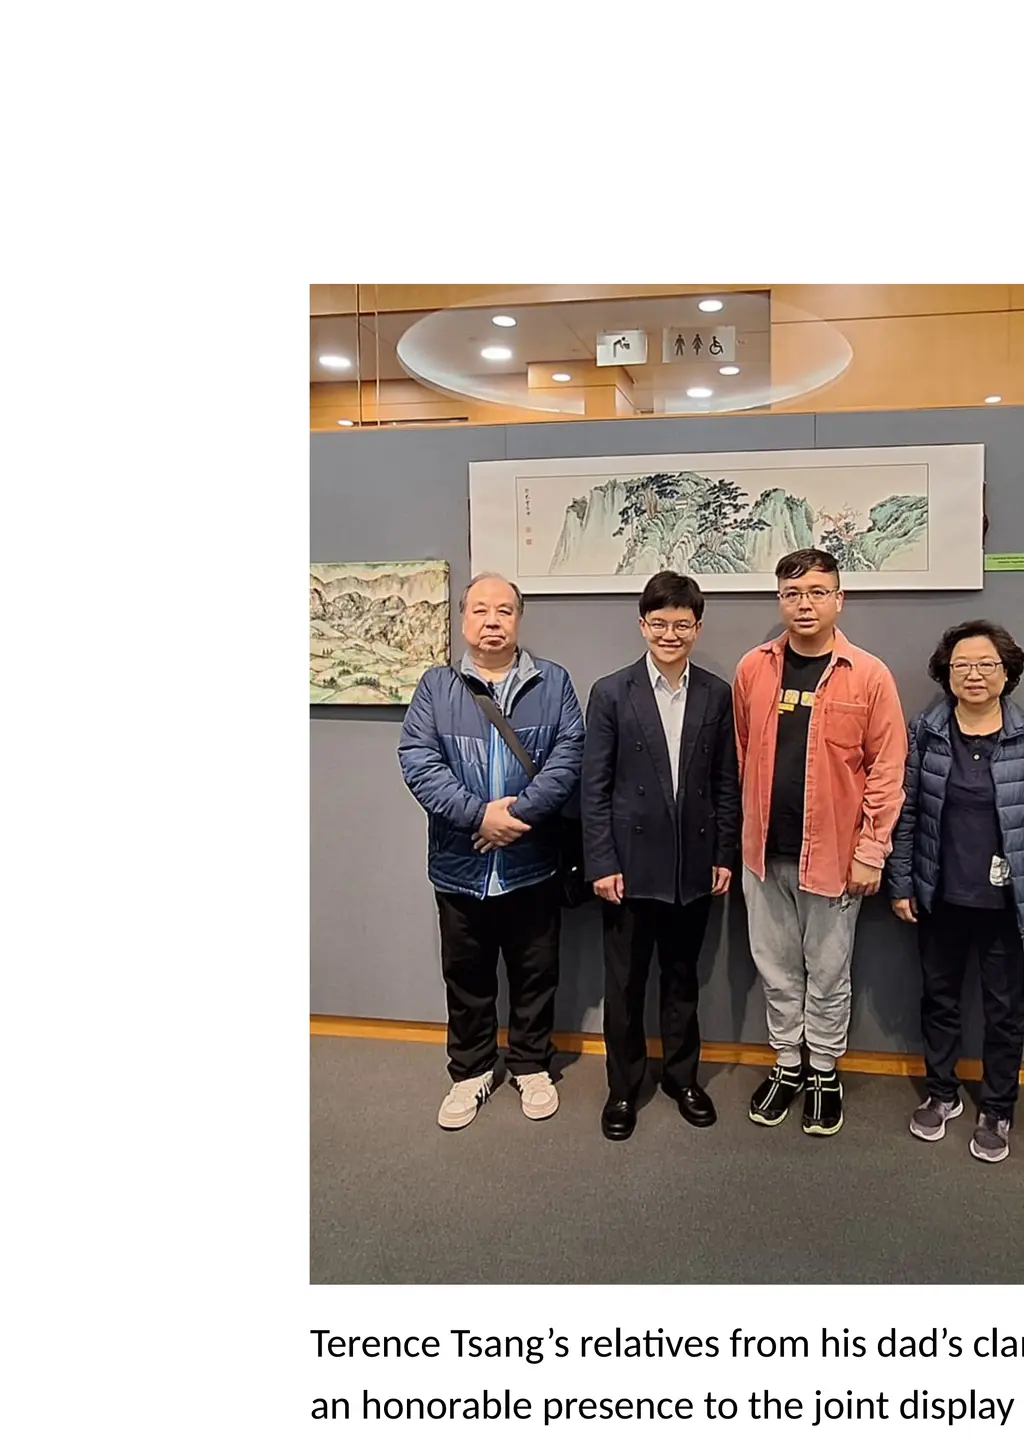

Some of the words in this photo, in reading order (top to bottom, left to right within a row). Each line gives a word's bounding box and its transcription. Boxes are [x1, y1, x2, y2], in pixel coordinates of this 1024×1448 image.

[310, 1330, 440, 1357] Terence
[451, 1328, 568, 1364] Tsang’s
[582, 1328, 719, 1357] relatives
[730, 1328, 808, 1357] from
[823, 1328, 866, 1357] his
[878, 1328, 962, 1357] dad’s
[312, 1399, 349, 1419] an
[364, 1390, 531, 1419] honorable
[545, 1398, 693, 1425] presence
[704, 1392, 737, 1419] to
[749, 1390, 802, 1419] the
[812, 1390, 889, 1426] joint
[900, 1390, 1014, 1425] display
